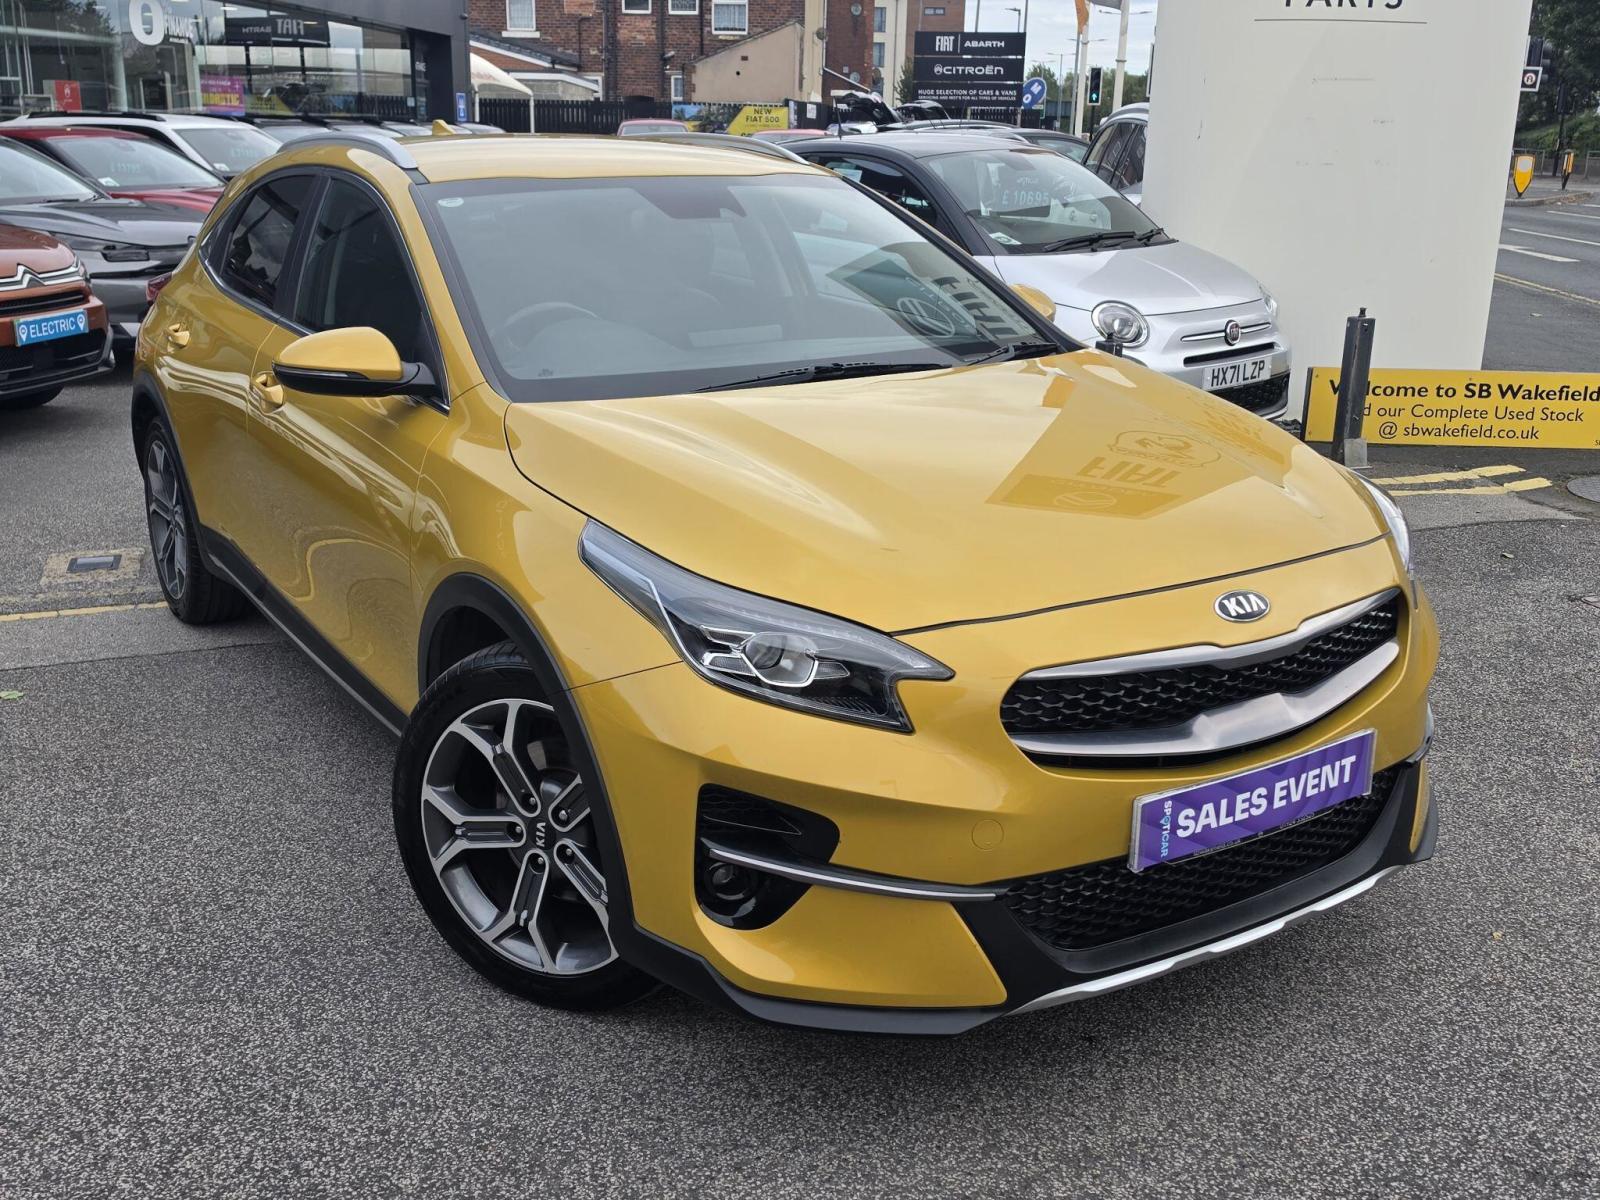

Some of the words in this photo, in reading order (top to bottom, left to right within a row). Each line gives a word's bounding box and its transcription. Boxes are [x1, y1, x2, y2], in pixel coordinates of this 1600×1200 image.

[935, 35, 955, 52] FIAT
[963, 40, 1005, 48] ABARTH
[29, 317, 76, 339] ELECTRIC
[1210, 364, 1241, 387] HX71
[1242, 360, 1266, 382] LZP
[1436, 384, 1457, 398] to
[1464, 382, 1492, 399] SB
[1498, 383, 1600, 402] Wakefield
[1377, 407, 1406, 417] our
[1411, 403, 1488, 423] Complete
[1494, 405, 1535, 421] Used
[1540, 406, 1585, 422] Stock
[1378, 421, 1398, 439] @
[1403, 423, 1540, 440] sbwakefield.co.uk
[1221, 594, 1267, 617] KIA
[1176, 787, 1268, 838] SALES
[1272, 754, 1357, 810] EVENT
[535, 822, 546, 848] KIA
[1160, 800, 1173, 858] SPOTICAR
